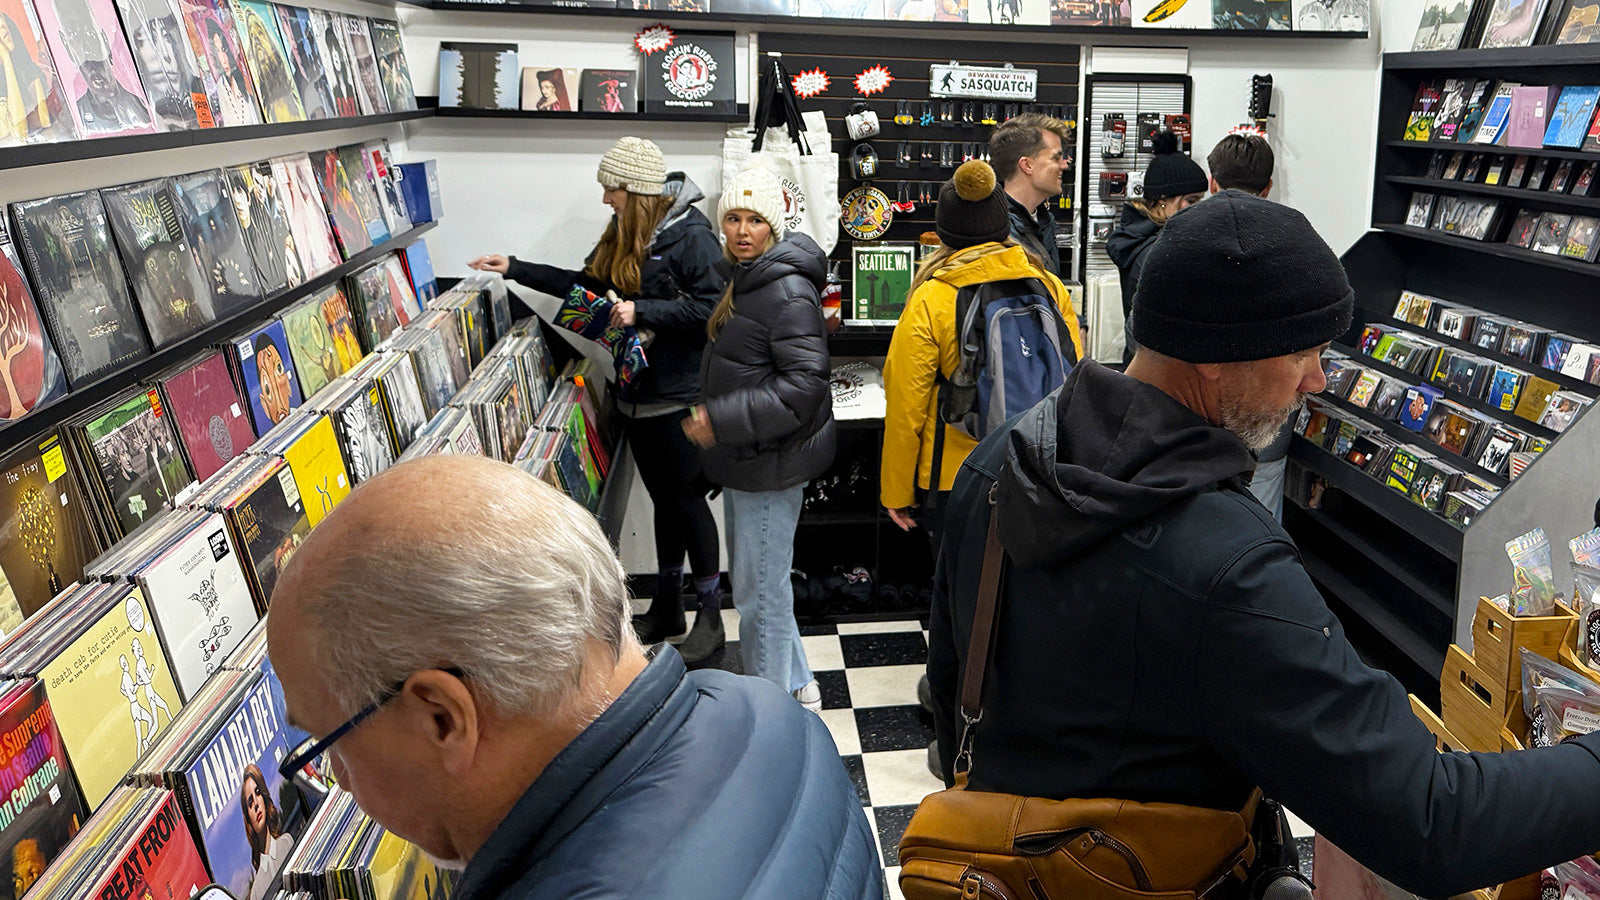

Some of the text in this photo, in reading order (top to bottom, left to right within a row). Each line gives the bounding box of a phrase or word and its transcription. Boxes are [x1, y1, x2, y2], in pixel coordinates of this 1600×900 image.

[661, 43, 718, 72] ROCKIN' RUBY'S
[664, 80, 714, 100] RECORDS
[960, 78, 1033, 93] SASQUATCH
[782, 178, 806, 203] RUBY'S
[6, 462, 39, 485] the fray
[51, 626, 119, 689] death cab for cutie
[74, 669, 84, 678] have
[90, 654, 100, 666] facts
[3, 700, 53, 758] Supreme
[1566, 711, 1584, 722] Freeze
[2, 731, 52, 794] in Seattle
[191, 676, 279, 830] LANA DEL REY
[11, 755, 59, 815] Coltrane
[138, 796, 181, 867] FROM
